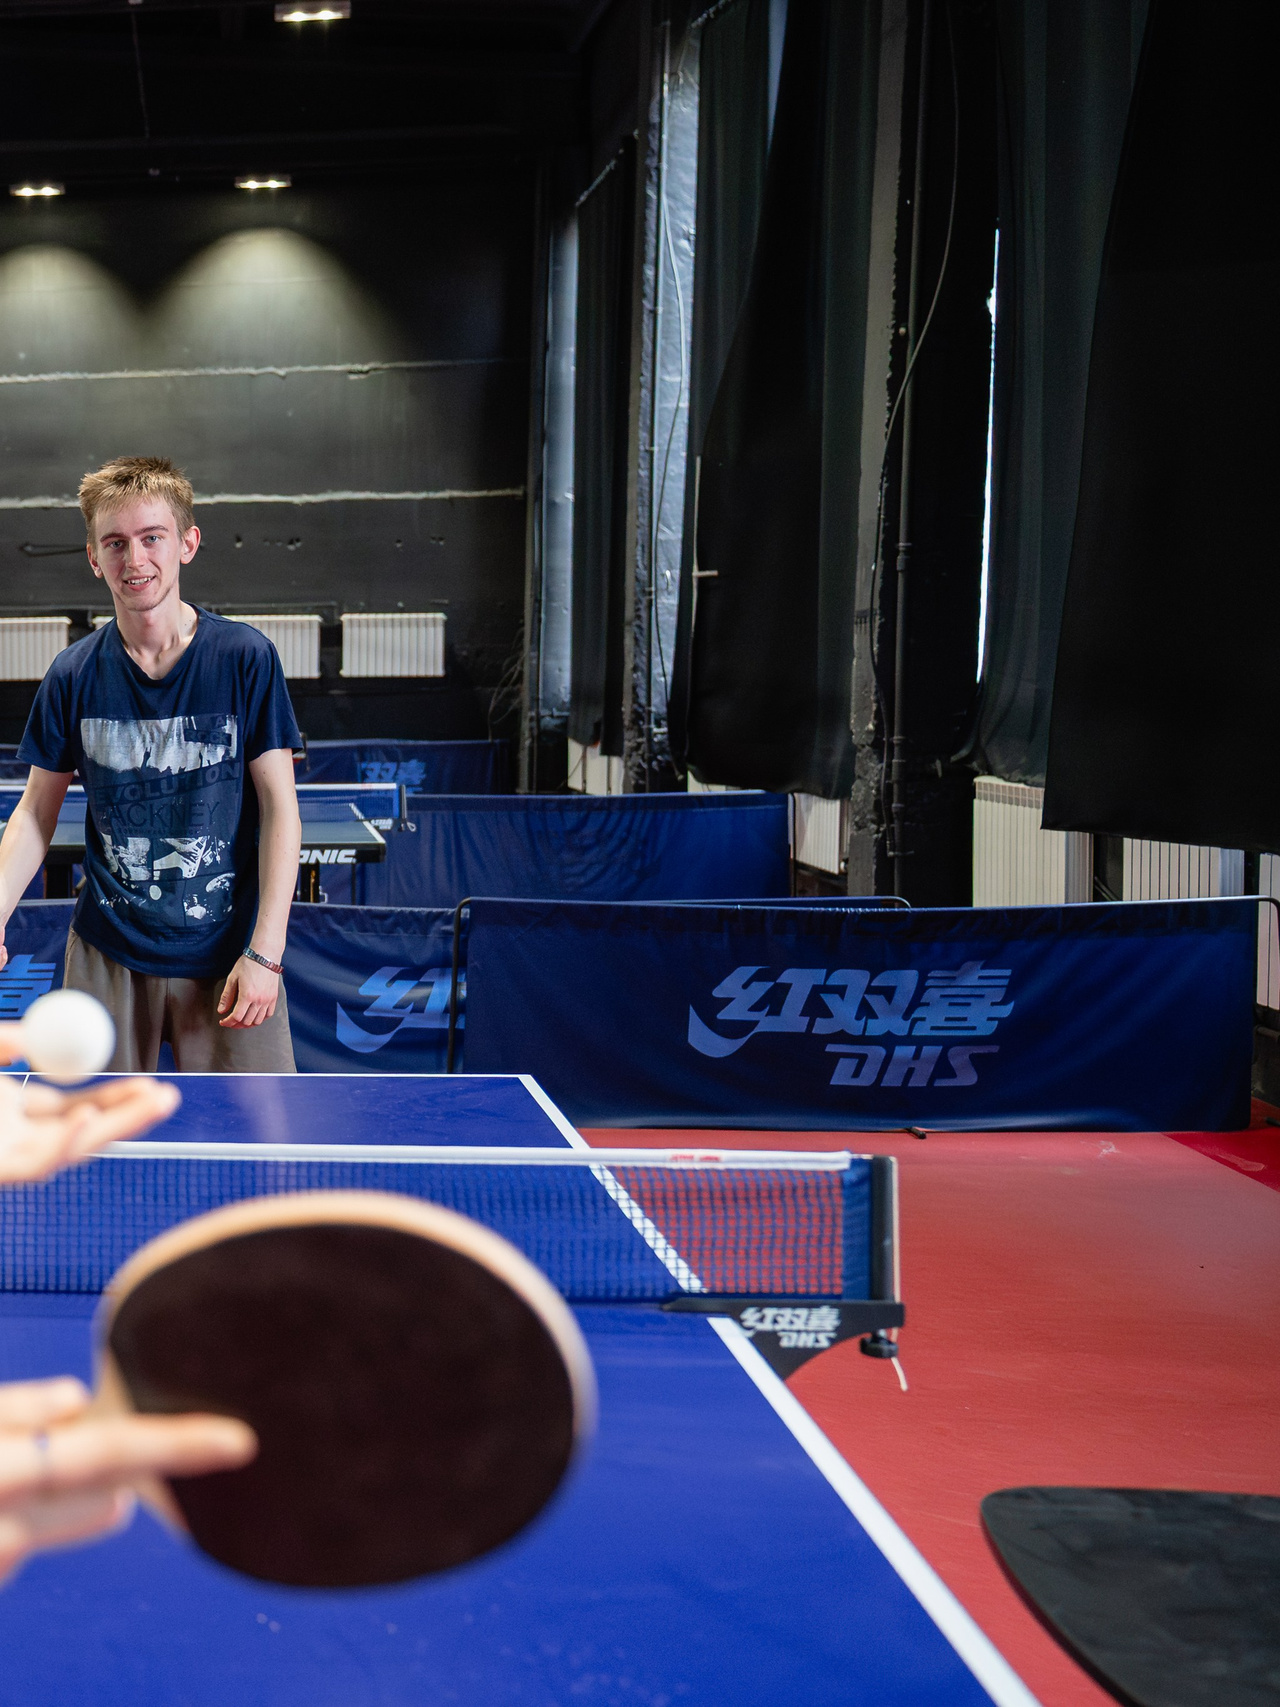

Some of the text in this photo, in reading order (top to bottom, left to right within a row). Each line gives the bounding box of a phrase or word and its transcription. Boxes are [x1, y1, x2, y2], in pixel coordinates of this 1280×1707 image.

[299, 849, 356, 864] ONIC
[687, 960, 1015, 1058] 红双喜
[824, 1043, 1000, 1087] DHS
[740, 1305, 842, 1338] 红双喜
[776, 1331, 837, 1348] DHS
